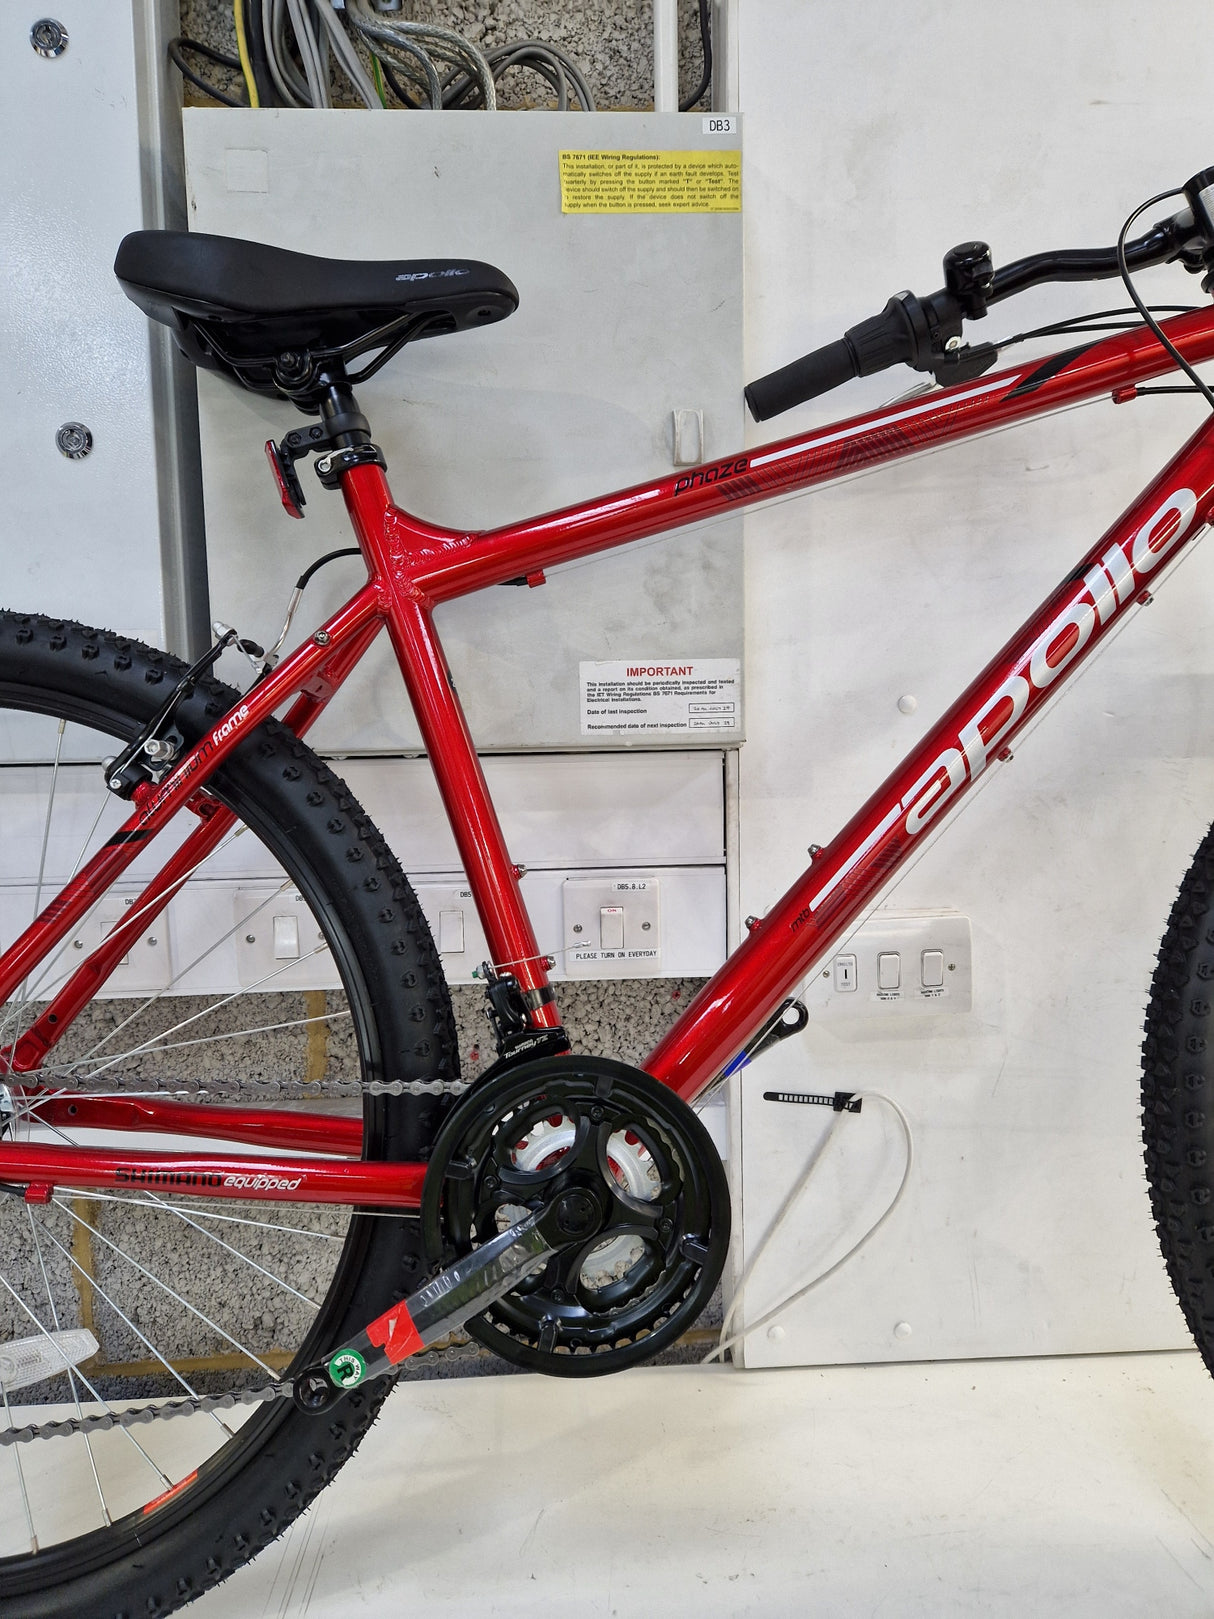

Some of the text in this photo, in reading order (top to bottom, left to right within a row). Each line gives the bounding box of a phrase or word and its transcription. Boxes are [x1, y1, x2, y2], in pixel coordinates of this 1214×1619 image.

[710, 119, 730, 132] DB3
[396, 268, 470, 281] apollo
[674, 458, 748, 496] phaze
[626, 666, 693, 676] IMPORTANT
[901, 488, 1198, 835] apollo
[212, 704, 249, 746] frame
[791, 908, 810, 932] mtb
[115, 1167, 301, 1191] SHIMANO equipped
[337, 1364, 354, 1380] R
